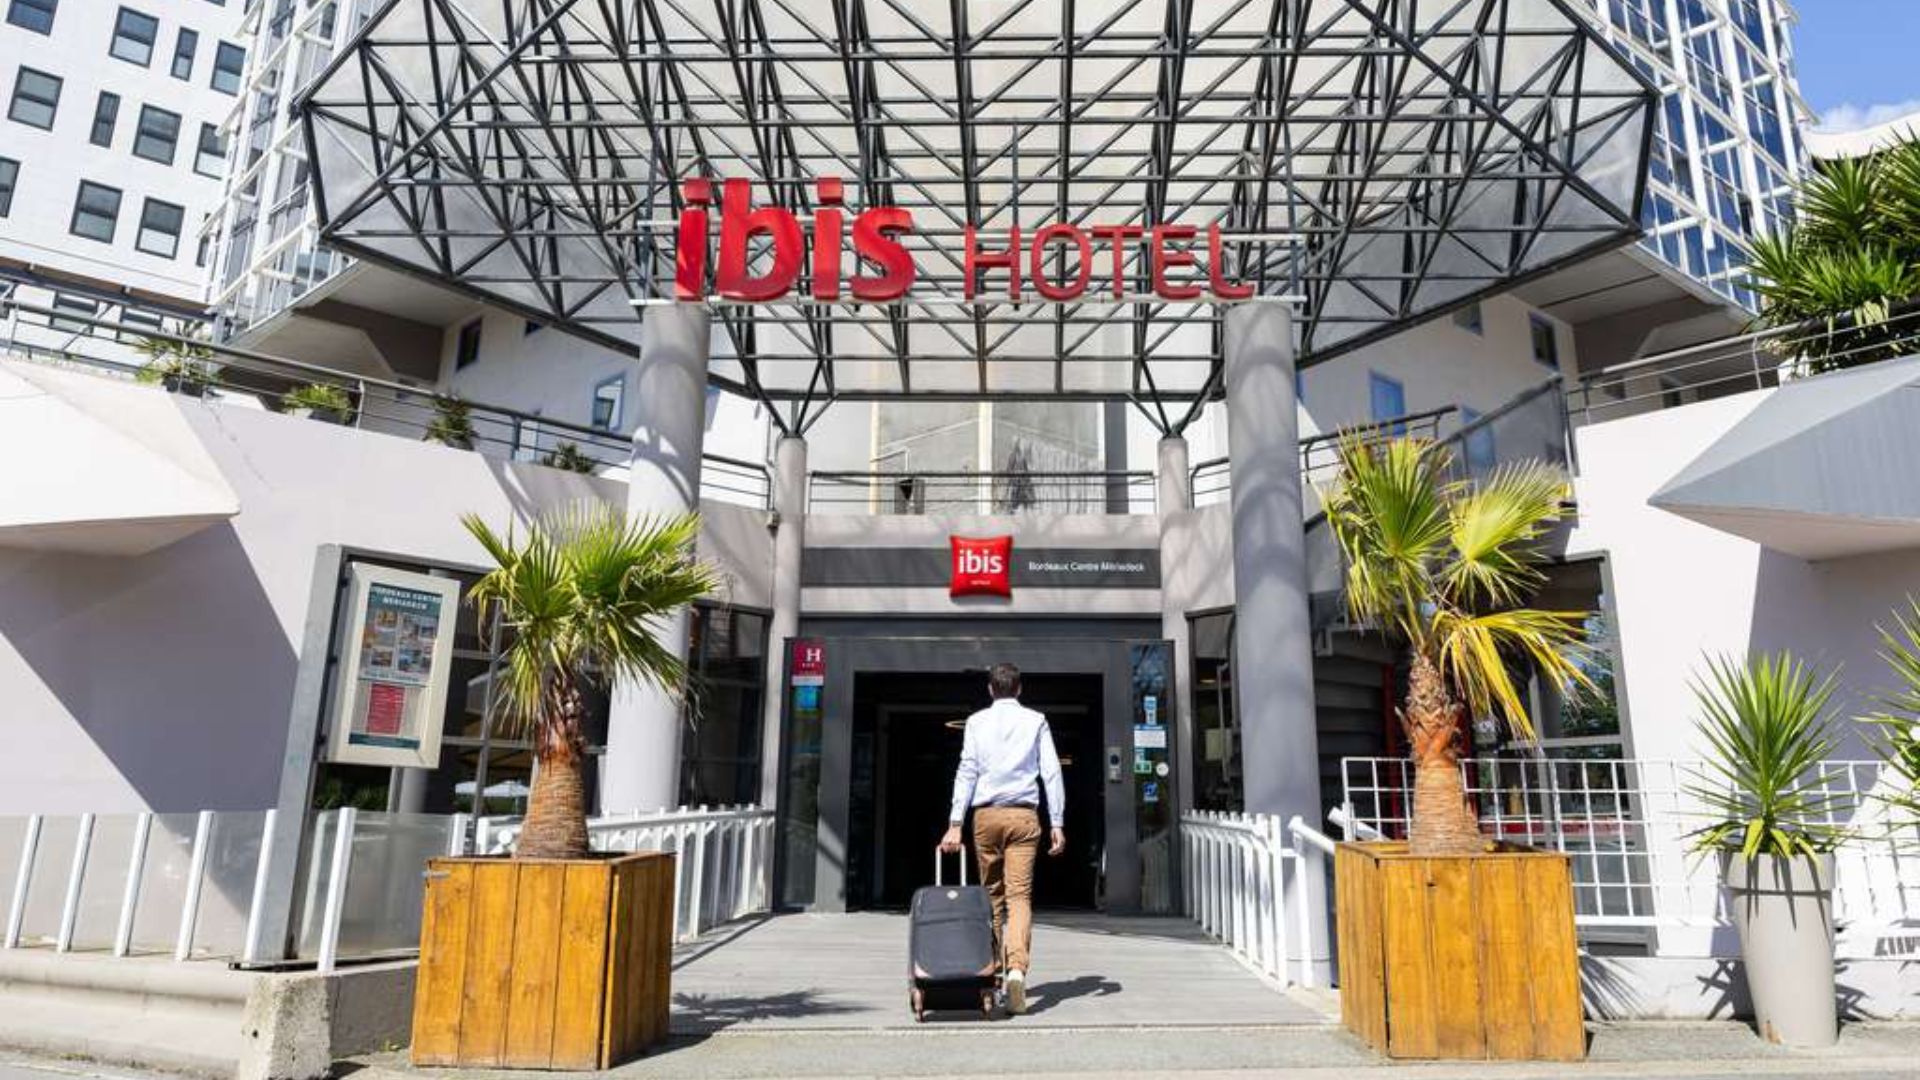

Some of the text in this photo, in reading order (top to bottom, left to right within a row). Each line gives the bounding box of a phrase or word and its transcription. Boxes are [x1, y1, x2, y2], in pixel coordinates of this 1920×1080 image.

[676, 177, 1255, 301] ibis HOTEL
[959, 549, 1003, 574] ibis
[1028, 560, 1069, 572] Bordeaux
[1070, 560, 1099, 572] Centre
[806, 647, 821, 662] H
